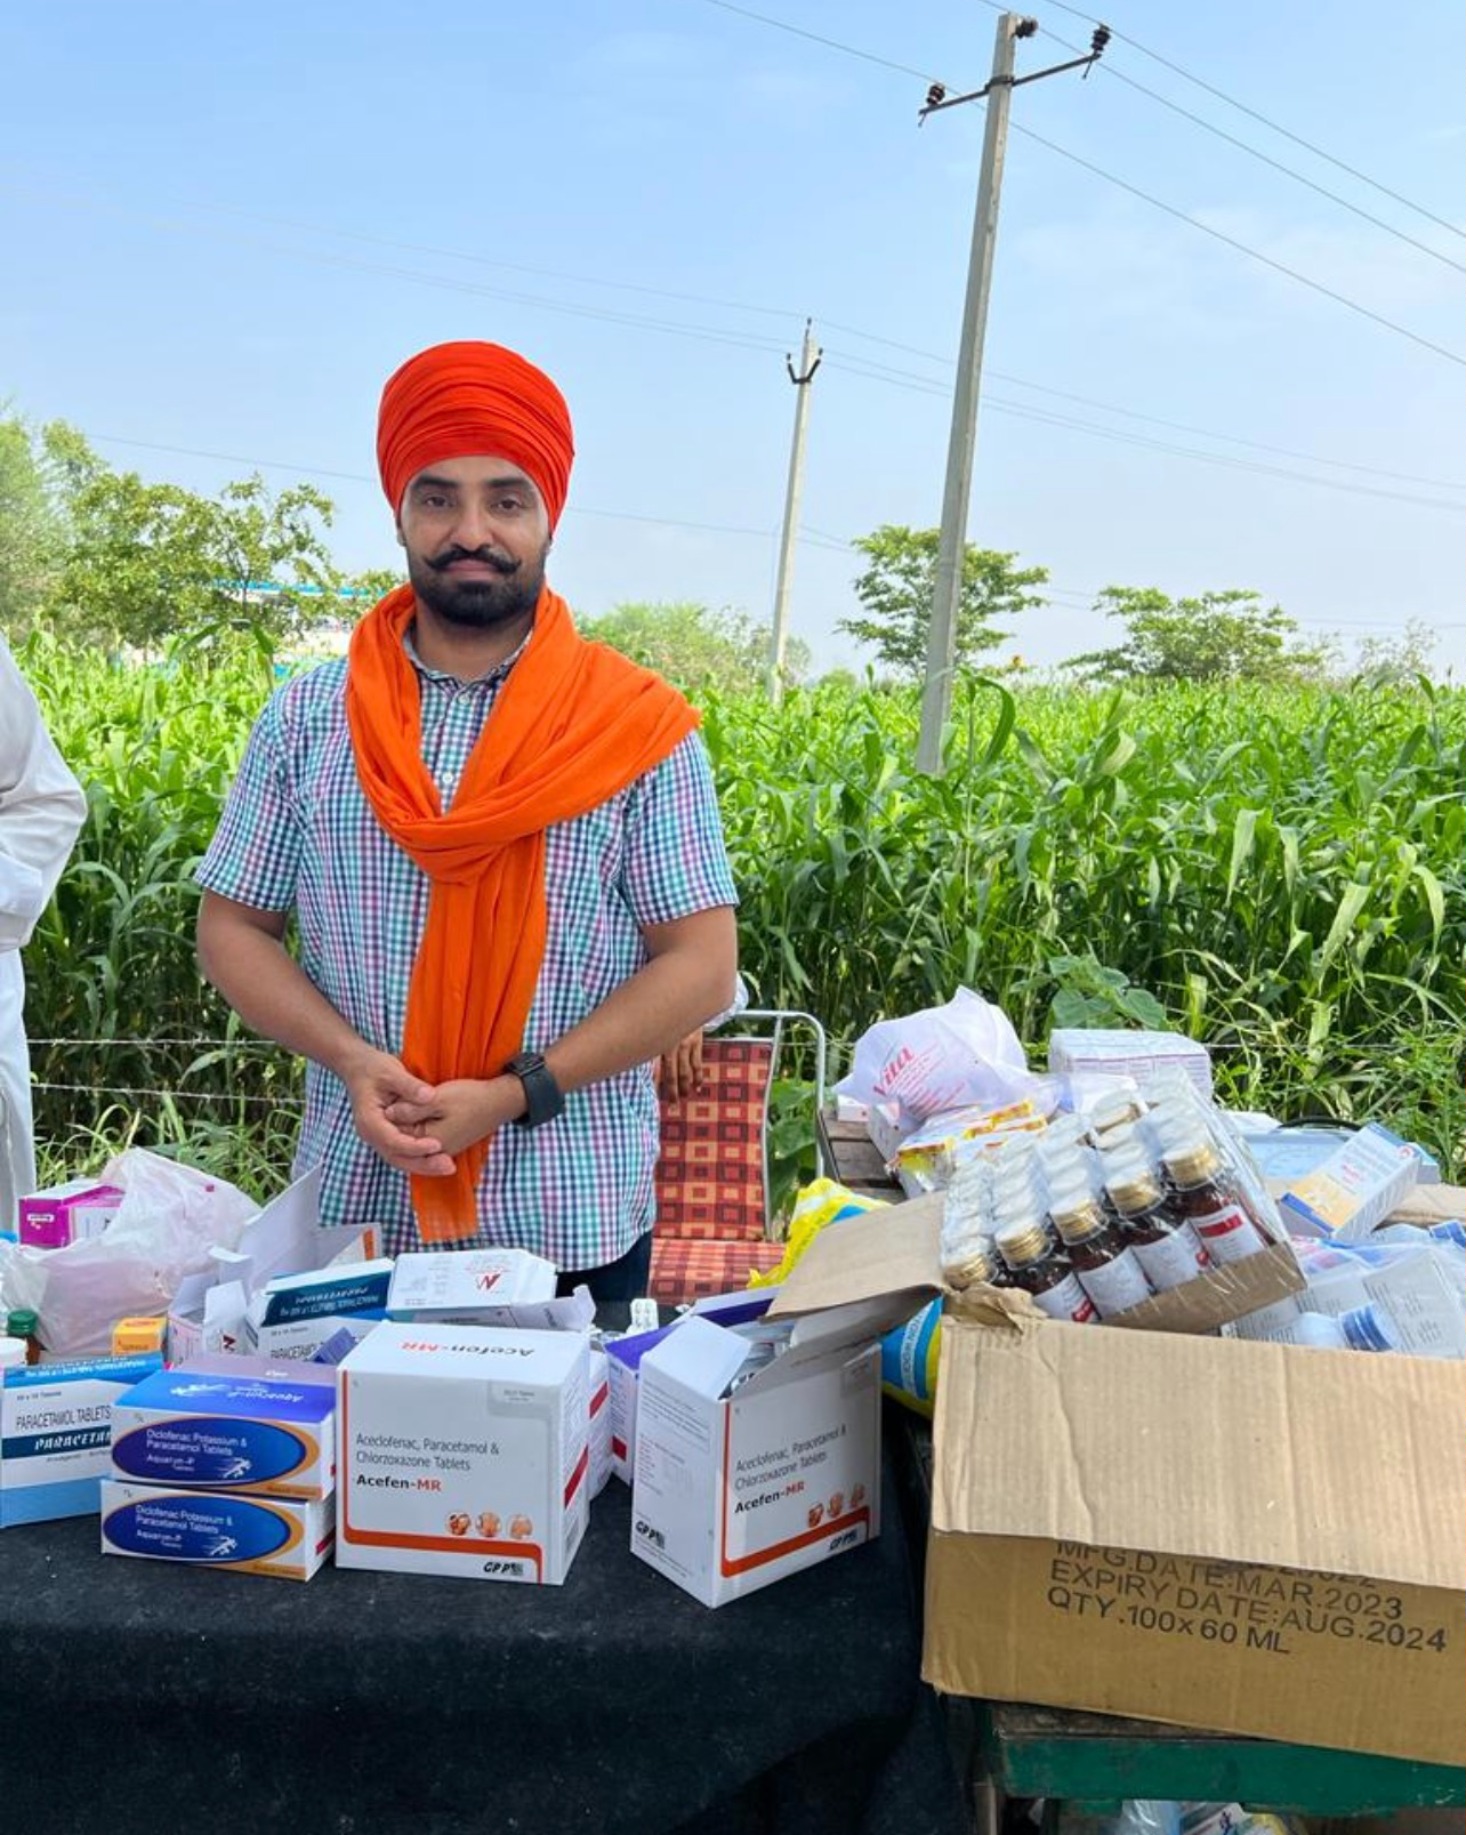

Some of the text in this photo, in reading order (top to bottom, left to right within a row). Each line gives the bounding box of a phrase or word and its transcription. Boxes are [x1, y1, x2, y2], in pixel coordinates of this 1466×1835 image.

[16, 1404, 112, 1431] PARACETAMOL TABLETS
[146, 1428, 192, 1443] Diclofenac
[194, 1433, 240, 1446] Potassium
[356, 1433, 500, 1455] Aceclofenac, Paracetamol &
[146, 1439, 233, 1456] Paracetamol Tablets
[356, 1451, 471, 1471] Chlorzoxazone Tablets
[356, 1473, 442, 1492] Acefen-MR
[735, 1480, 805, 1514] Acefen-MR
[135, 1504, 179, 1518] Diclofenac
[135, 1515, 219, 1534] Paracetamol Tablets
[1050, 1559, 1171, 1599] EXPIRY
[1245, 1626, 1291, 1655] ML
